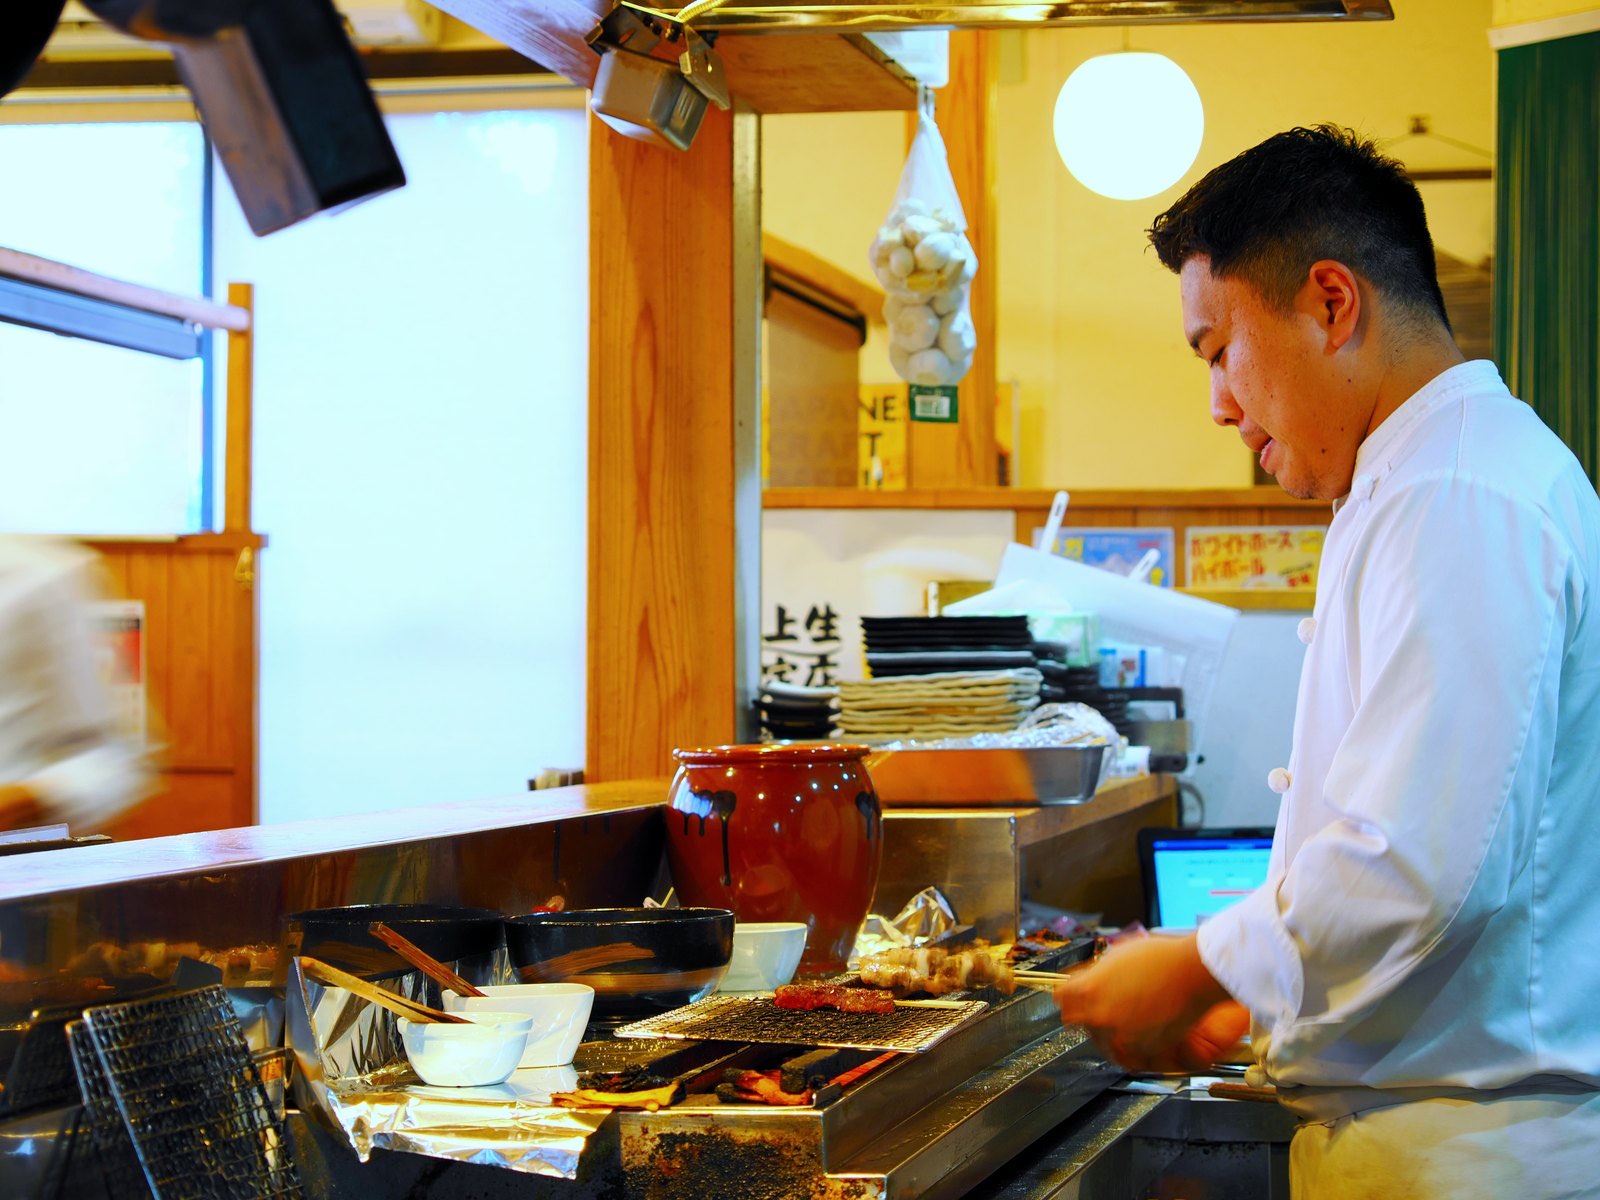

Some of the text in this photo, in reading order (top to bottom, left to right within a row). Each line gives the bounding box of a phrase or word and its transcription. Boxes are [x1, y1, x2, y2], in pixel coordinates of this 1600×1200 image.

[1191, 529, 1293, 557] ホワイトホース
[1191, 557, 1265, 584] ハイボール
